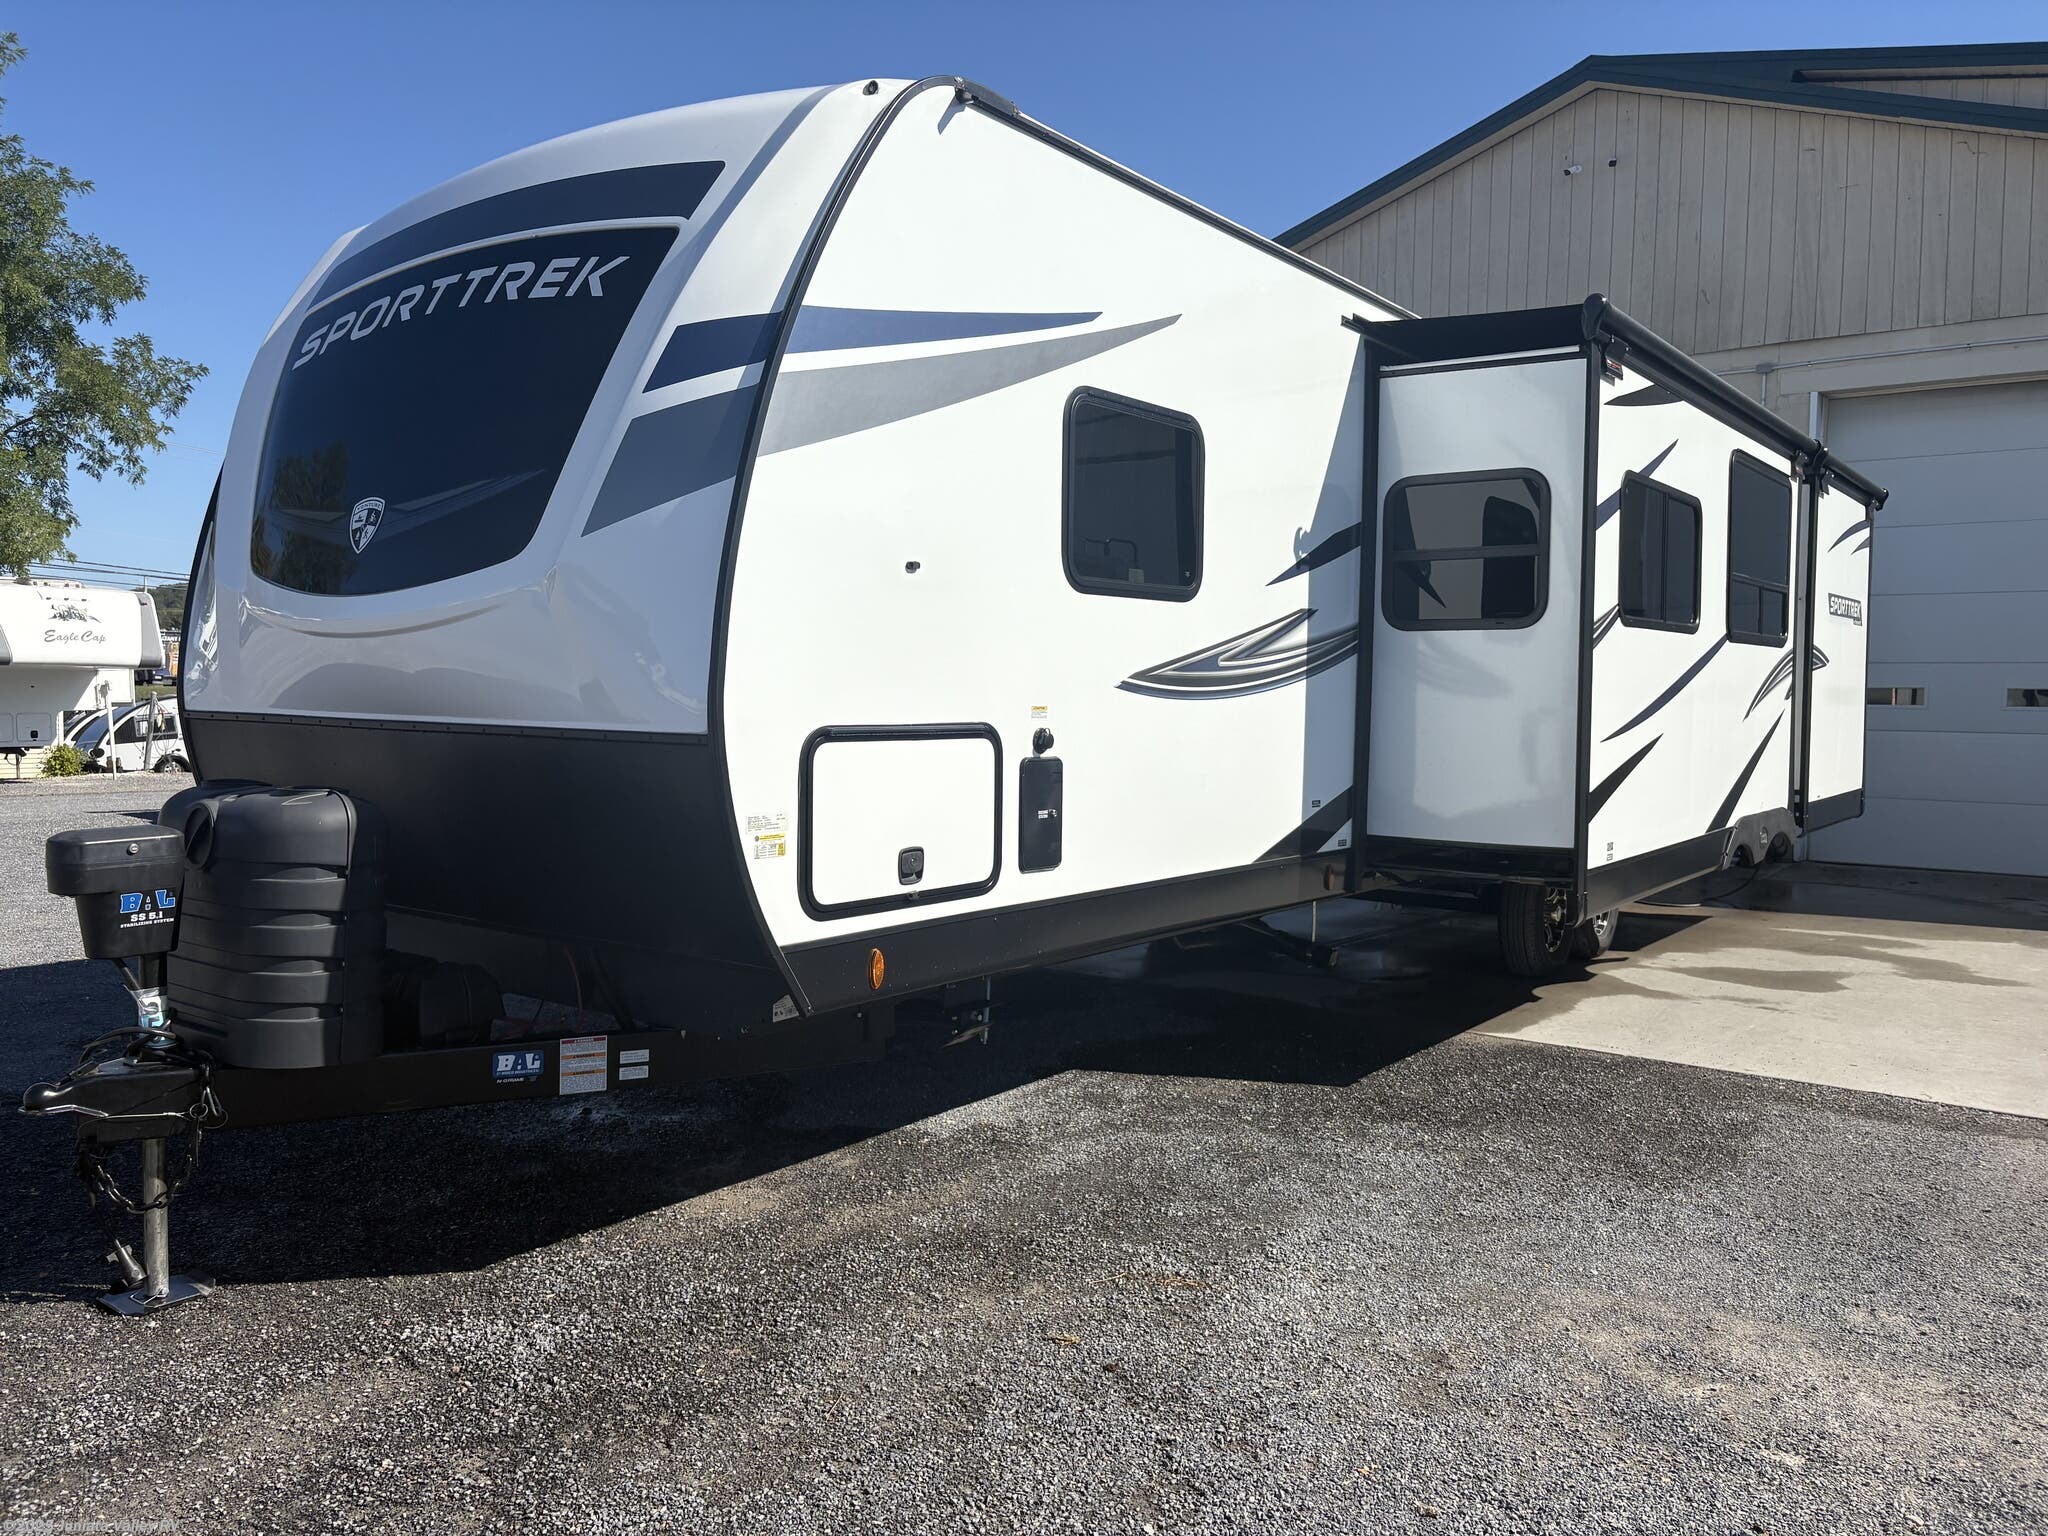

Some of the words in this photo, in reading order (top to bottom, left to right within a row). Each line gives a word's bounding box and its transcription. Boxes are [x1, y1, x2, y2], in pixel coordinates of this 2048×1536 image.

[292, 256, 630, 371] SPORTTREK
[1830, 595, 1861, 618] SPORTTREK
[44, 629, 80, 644] Eagle
[80, 630, 106, 644] Cap
[120, 889, 176, 913] BAL
[131, 912, 147, 922] SS
[148, 911, 163, 920] 5.1
[497, 1053, 541, 1071] BAL
